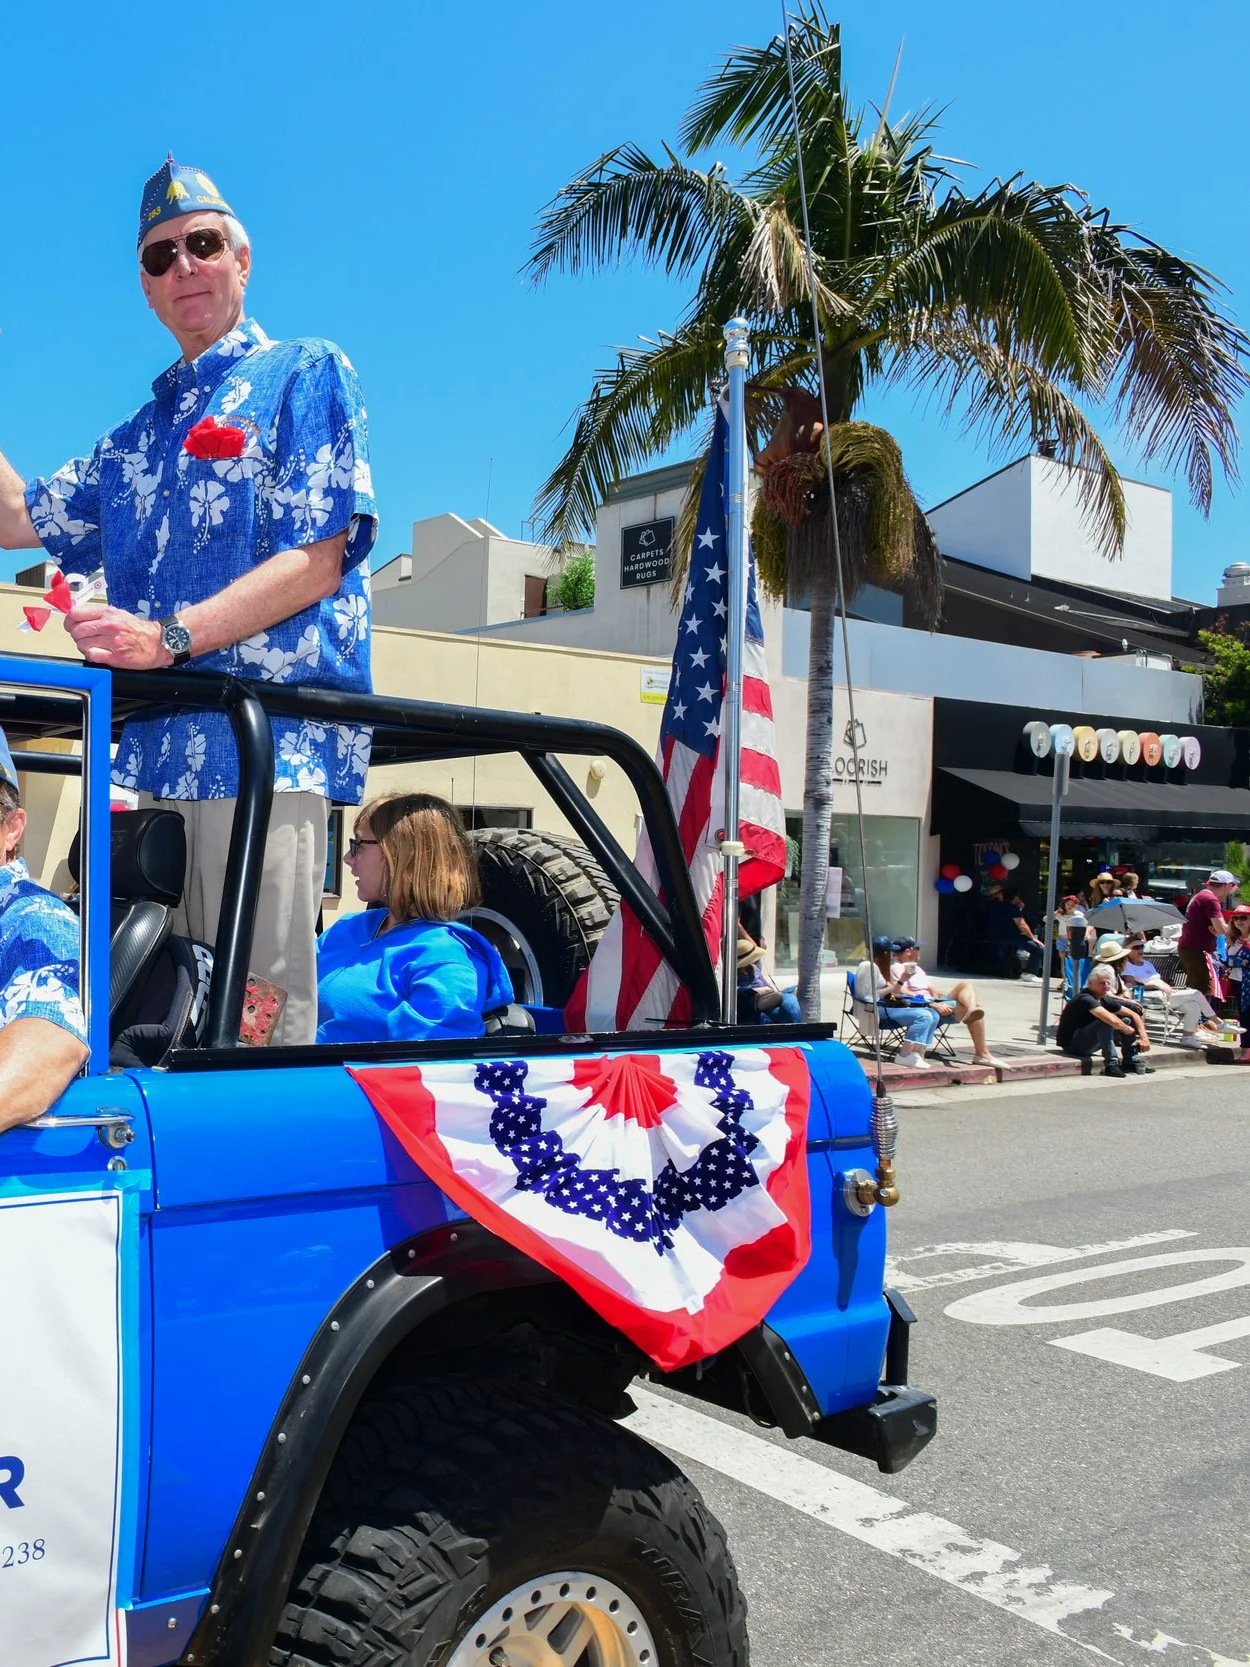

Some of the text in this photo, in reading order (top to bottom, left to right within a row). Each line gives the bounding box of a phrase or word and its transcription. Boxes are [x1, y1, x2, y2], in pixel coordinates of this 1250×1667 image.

[630, 549, 664, 561] CARPETS
[624, 558, 670, 572] HARDWOOD
[636, 570, 657, 580] RUGS
[834, 757, 888, 777] OORISH
[1, 1538, 47, 1570] 238
